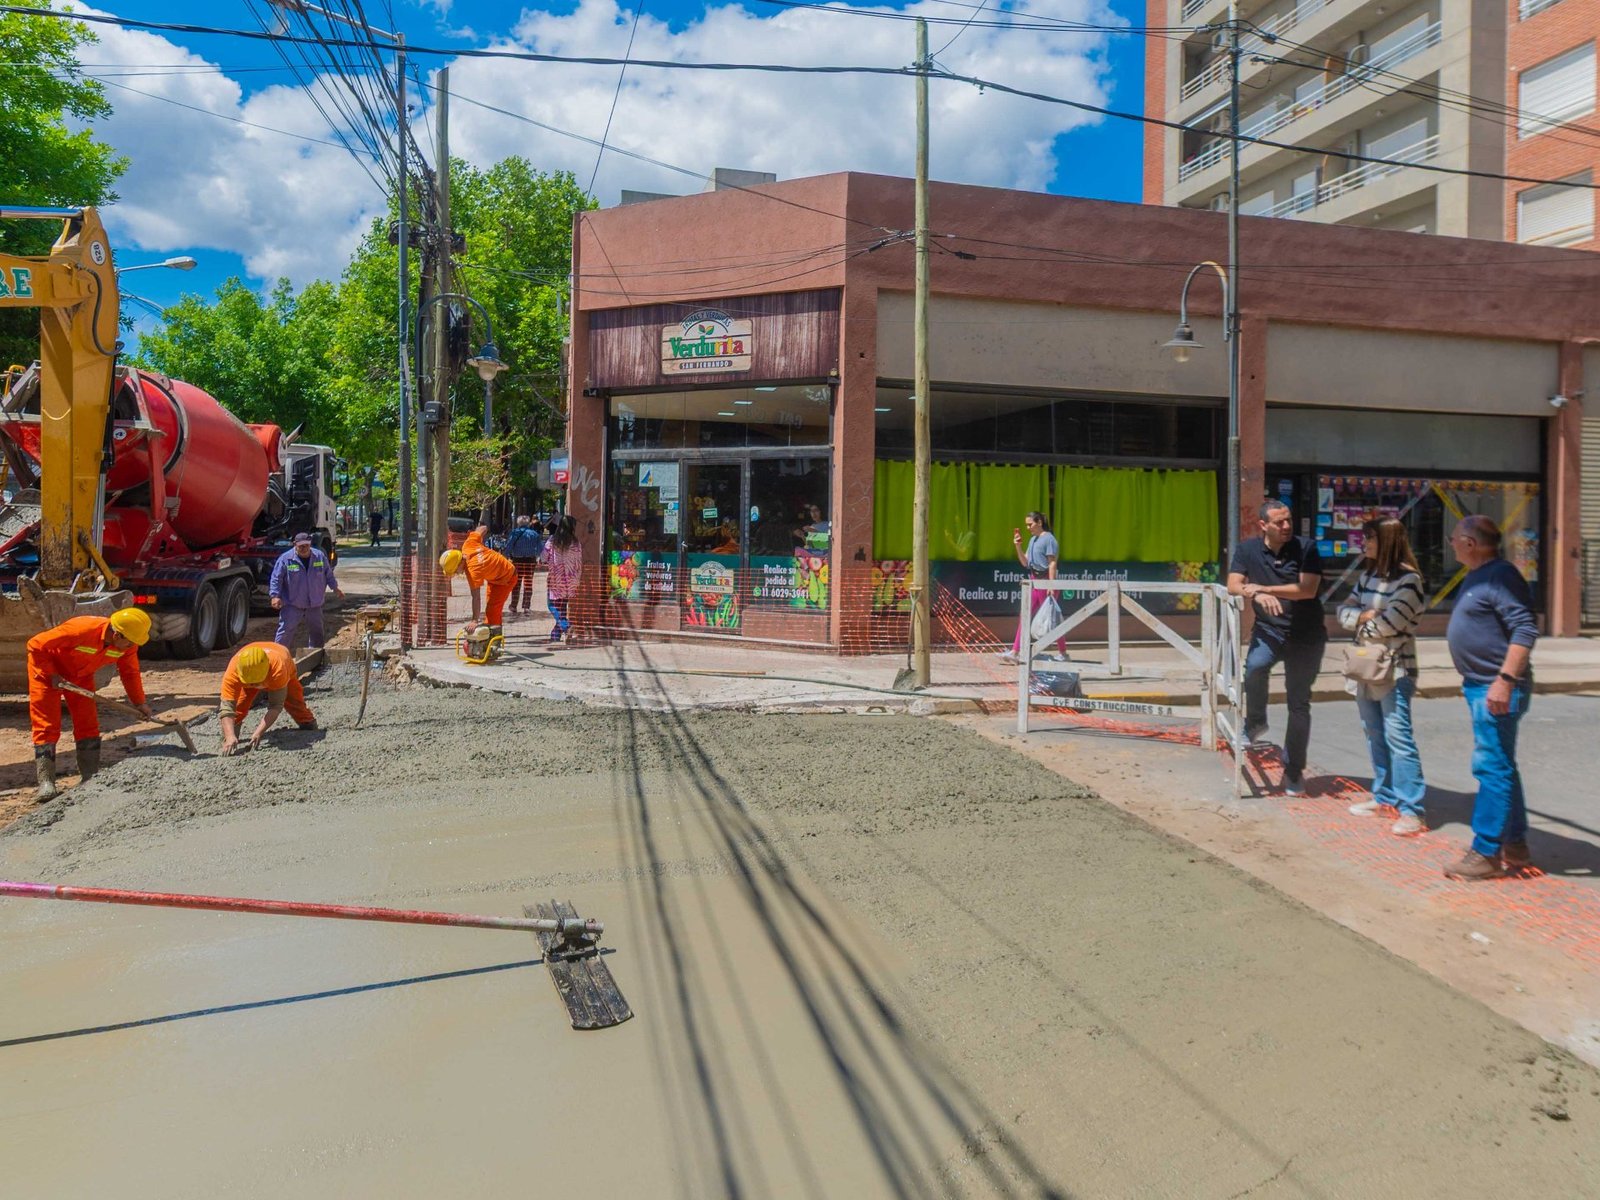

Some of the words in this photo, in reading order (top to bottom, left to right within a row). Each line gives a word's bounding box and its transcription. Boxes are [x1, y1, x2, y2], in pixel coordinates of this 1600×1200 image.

[682, 313, 700, 330] FRUTAS
[706, 310, 732, 328] VERDURAS
[669, 334, 744, 358] Verdurita
[696, 360, 729, 369] FERNANDO
[647, 560, 665, 569] Frutas
[666, 562, 671, 571] y
[764, 564, 787, 574] Realice
[765, 575, 787, 587] pedido
[788, 576, 795, 586] al
[994, 570, 1025, 582] Frutas
[1081, 569, 1093, 580] de
[1096, 569, 1128, 581] calidad
[645, 581, 652, 590] de
[762, 587, 769, 597] 11
[959, 587, 993, 600] Realice
[997, 590, 1009, 600] su
[1074, 698, 1153, 715] CONSTRUCCIONES
